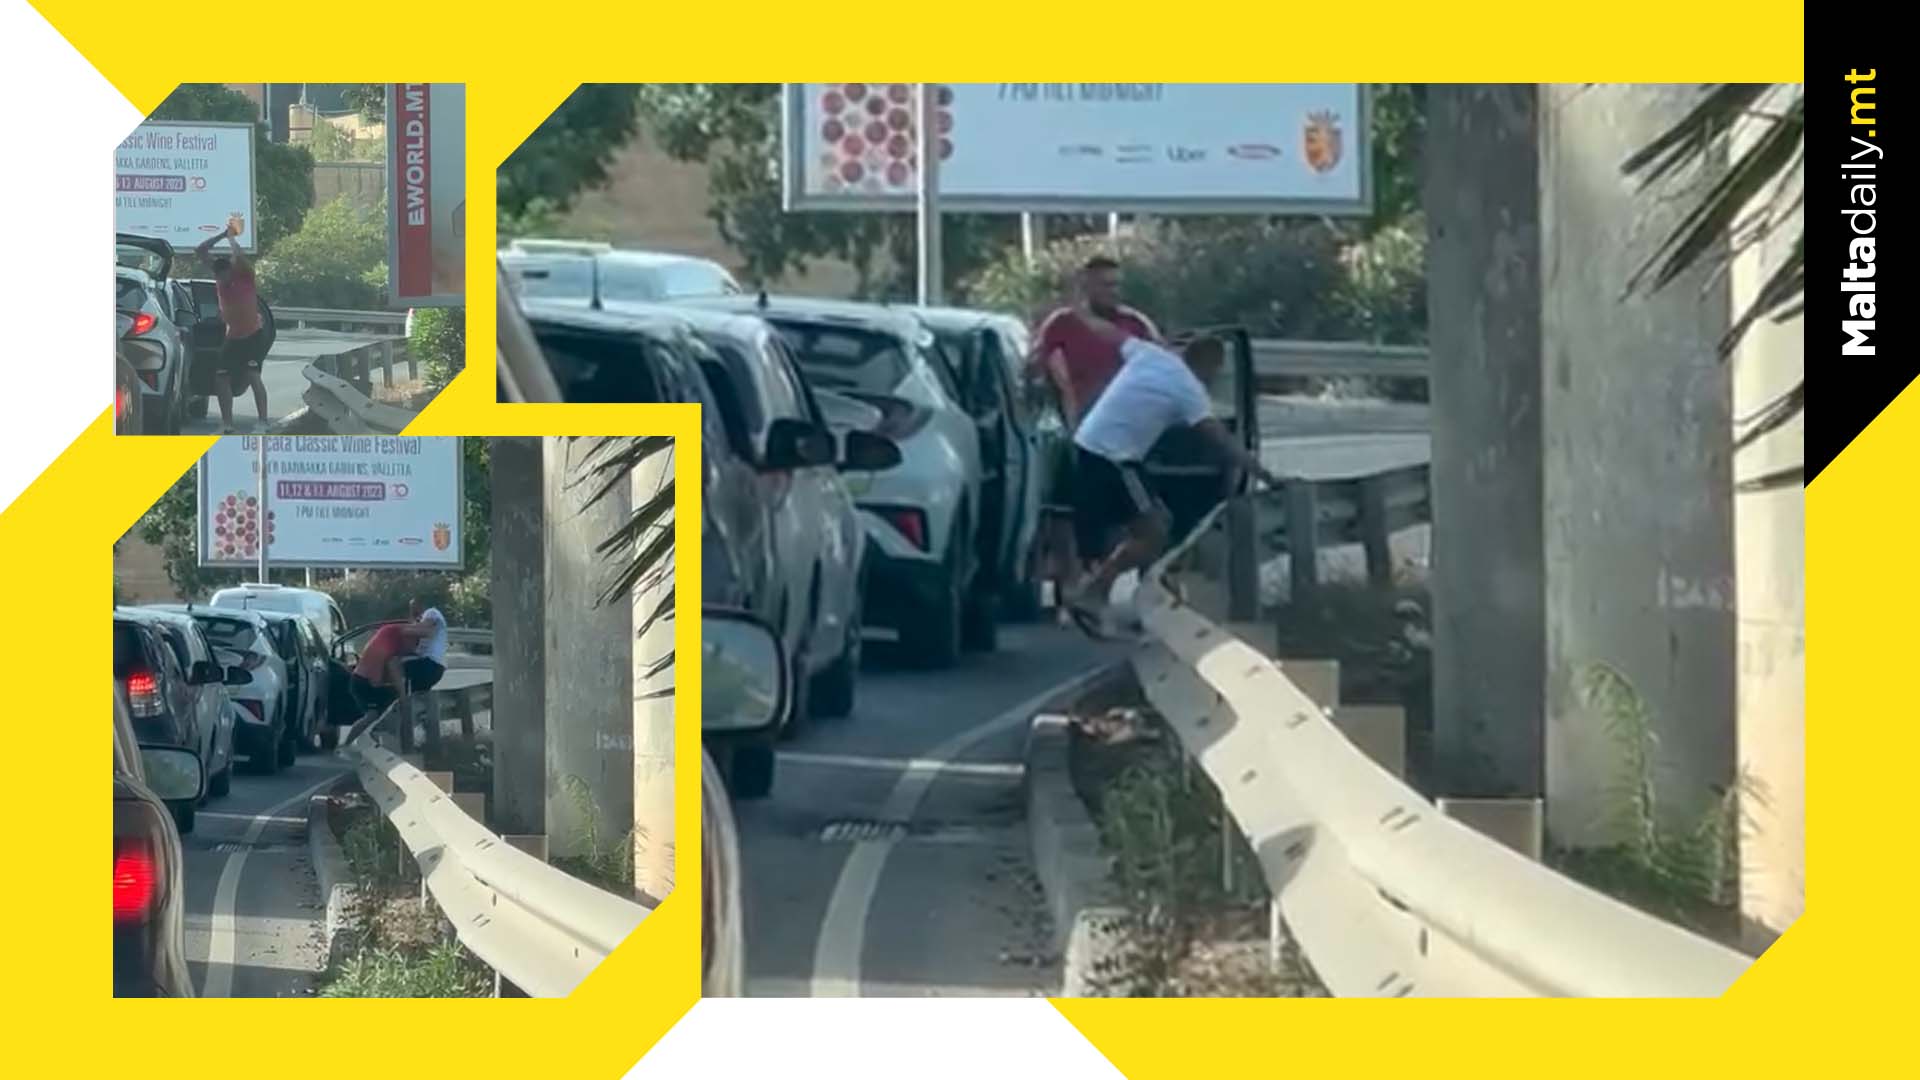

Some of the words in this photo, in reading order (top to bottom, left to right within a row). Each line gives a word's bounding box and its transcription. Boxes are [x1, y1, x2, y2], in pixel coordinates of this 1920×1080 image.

[146, 132, 173, 150] Wine
[176, 132, 217, 151] Festival
[296, 436, 338, 452] Classic
[341, 436, 371, 454] Wine
[375, 436, 421, 455] Festival
